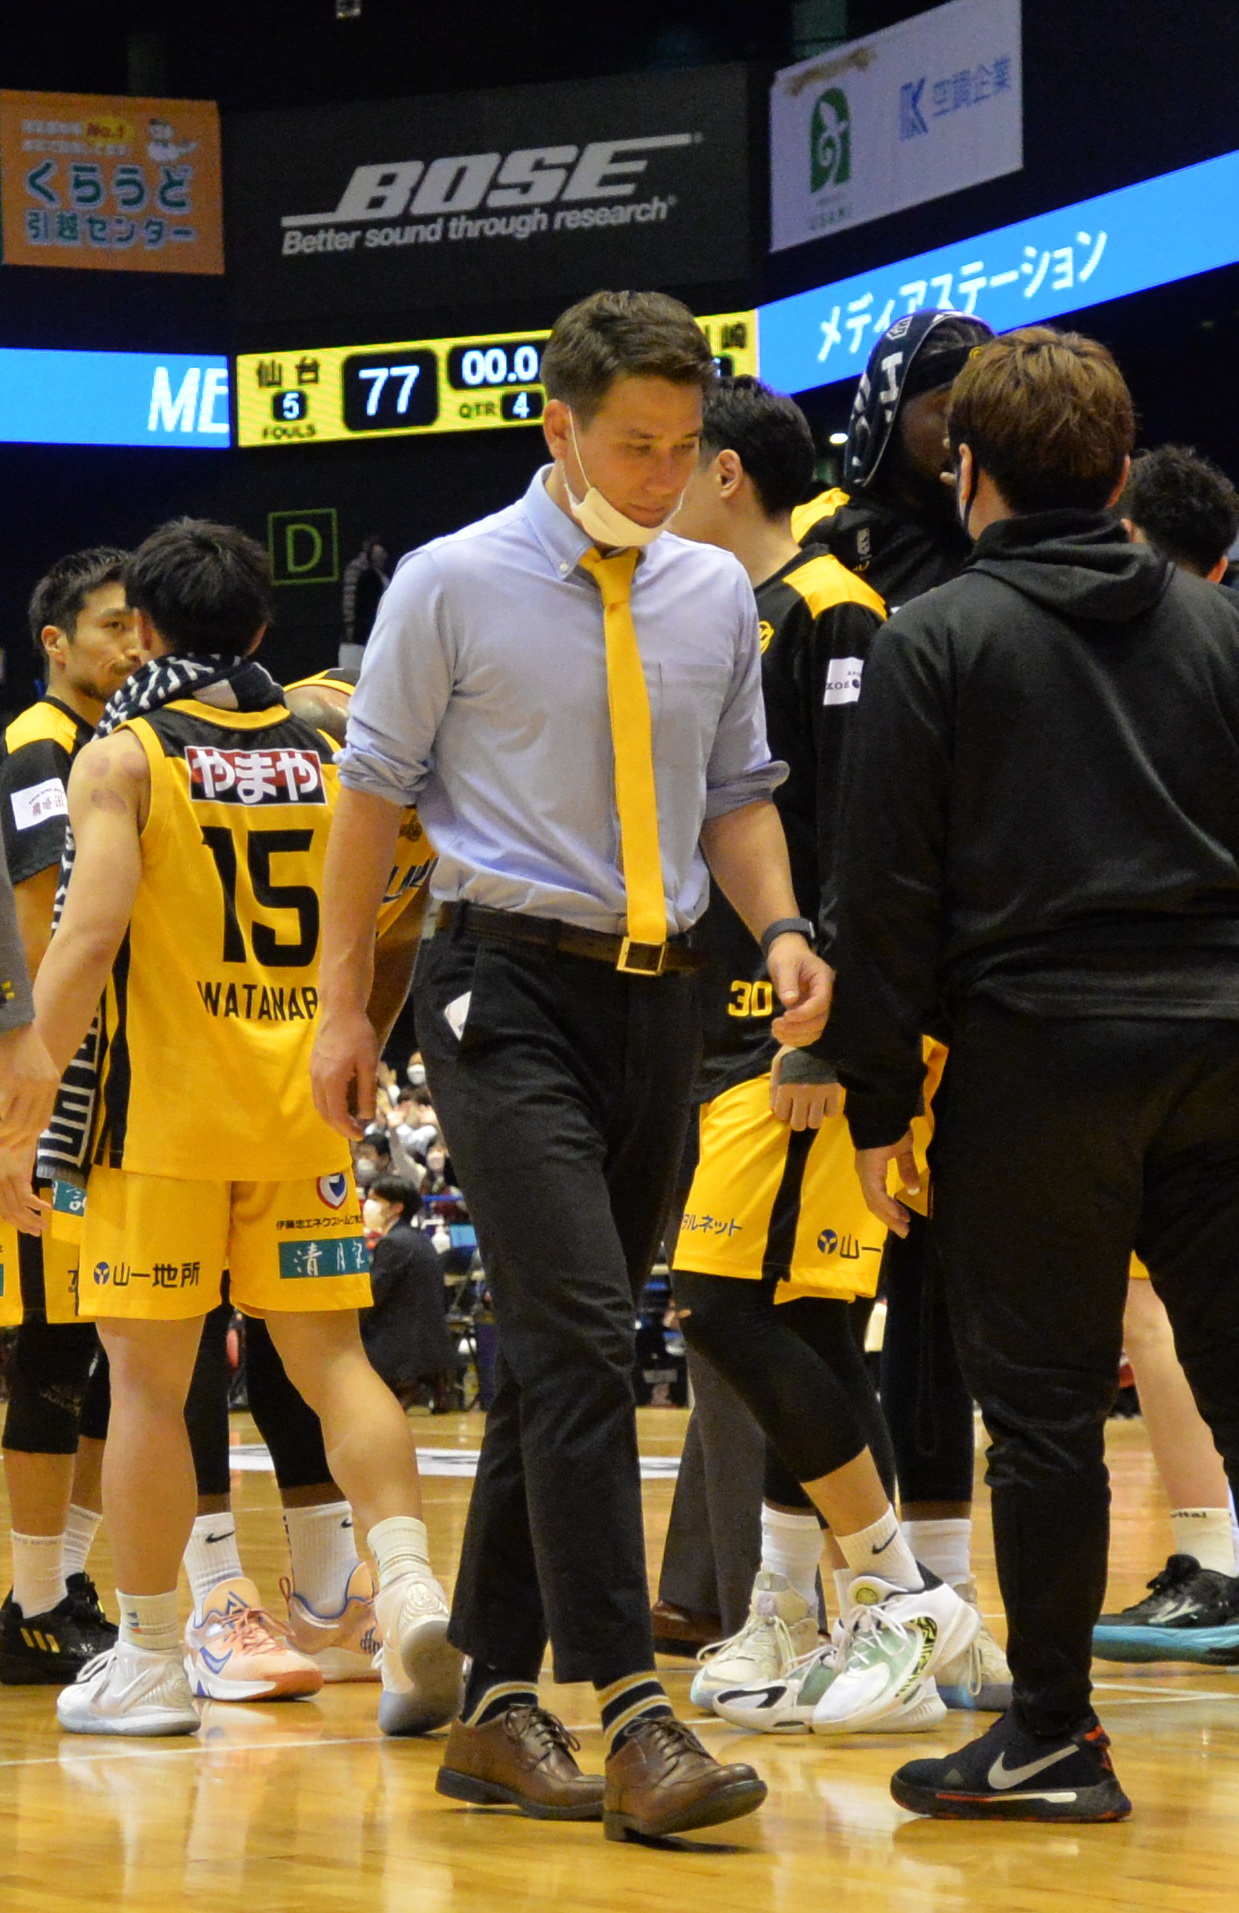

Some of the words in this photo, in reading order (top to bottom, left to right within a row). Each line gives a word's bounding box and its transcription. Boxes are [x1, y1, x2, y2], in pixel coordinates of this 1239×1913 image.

[23, 157, 196, 215] くらうど
[281, 133, 693, 227] BOSE
[24, 209, 197, 250] 引越センター
[281, 227, 359, 256] Better
[364, 220, 443, 248] sound
[447, 203, 549, 240] through
[553, 197, 669, 230] research
[818, 230, 1108, 363] メディアステーション
[256, 356, 321, 389] 仙台
[358, 365, 421, 417] 77
[461, 345, 539, 386] 00.0
[147, 365, 230, 433] ME
[282, 391, 300, 420] 5
[458, 401, 497, 419] QTR
[511, 392, 531, 418] 4
[261, 423, 317, 441] FOULS
[285, 523, 323, 574] D
[193, 749, 319, 804] やまや
[200, 825, 320, 968] 15
[728, 980, 773, 1018] 30
[112, 1261, 201, 1288] 山一地所
